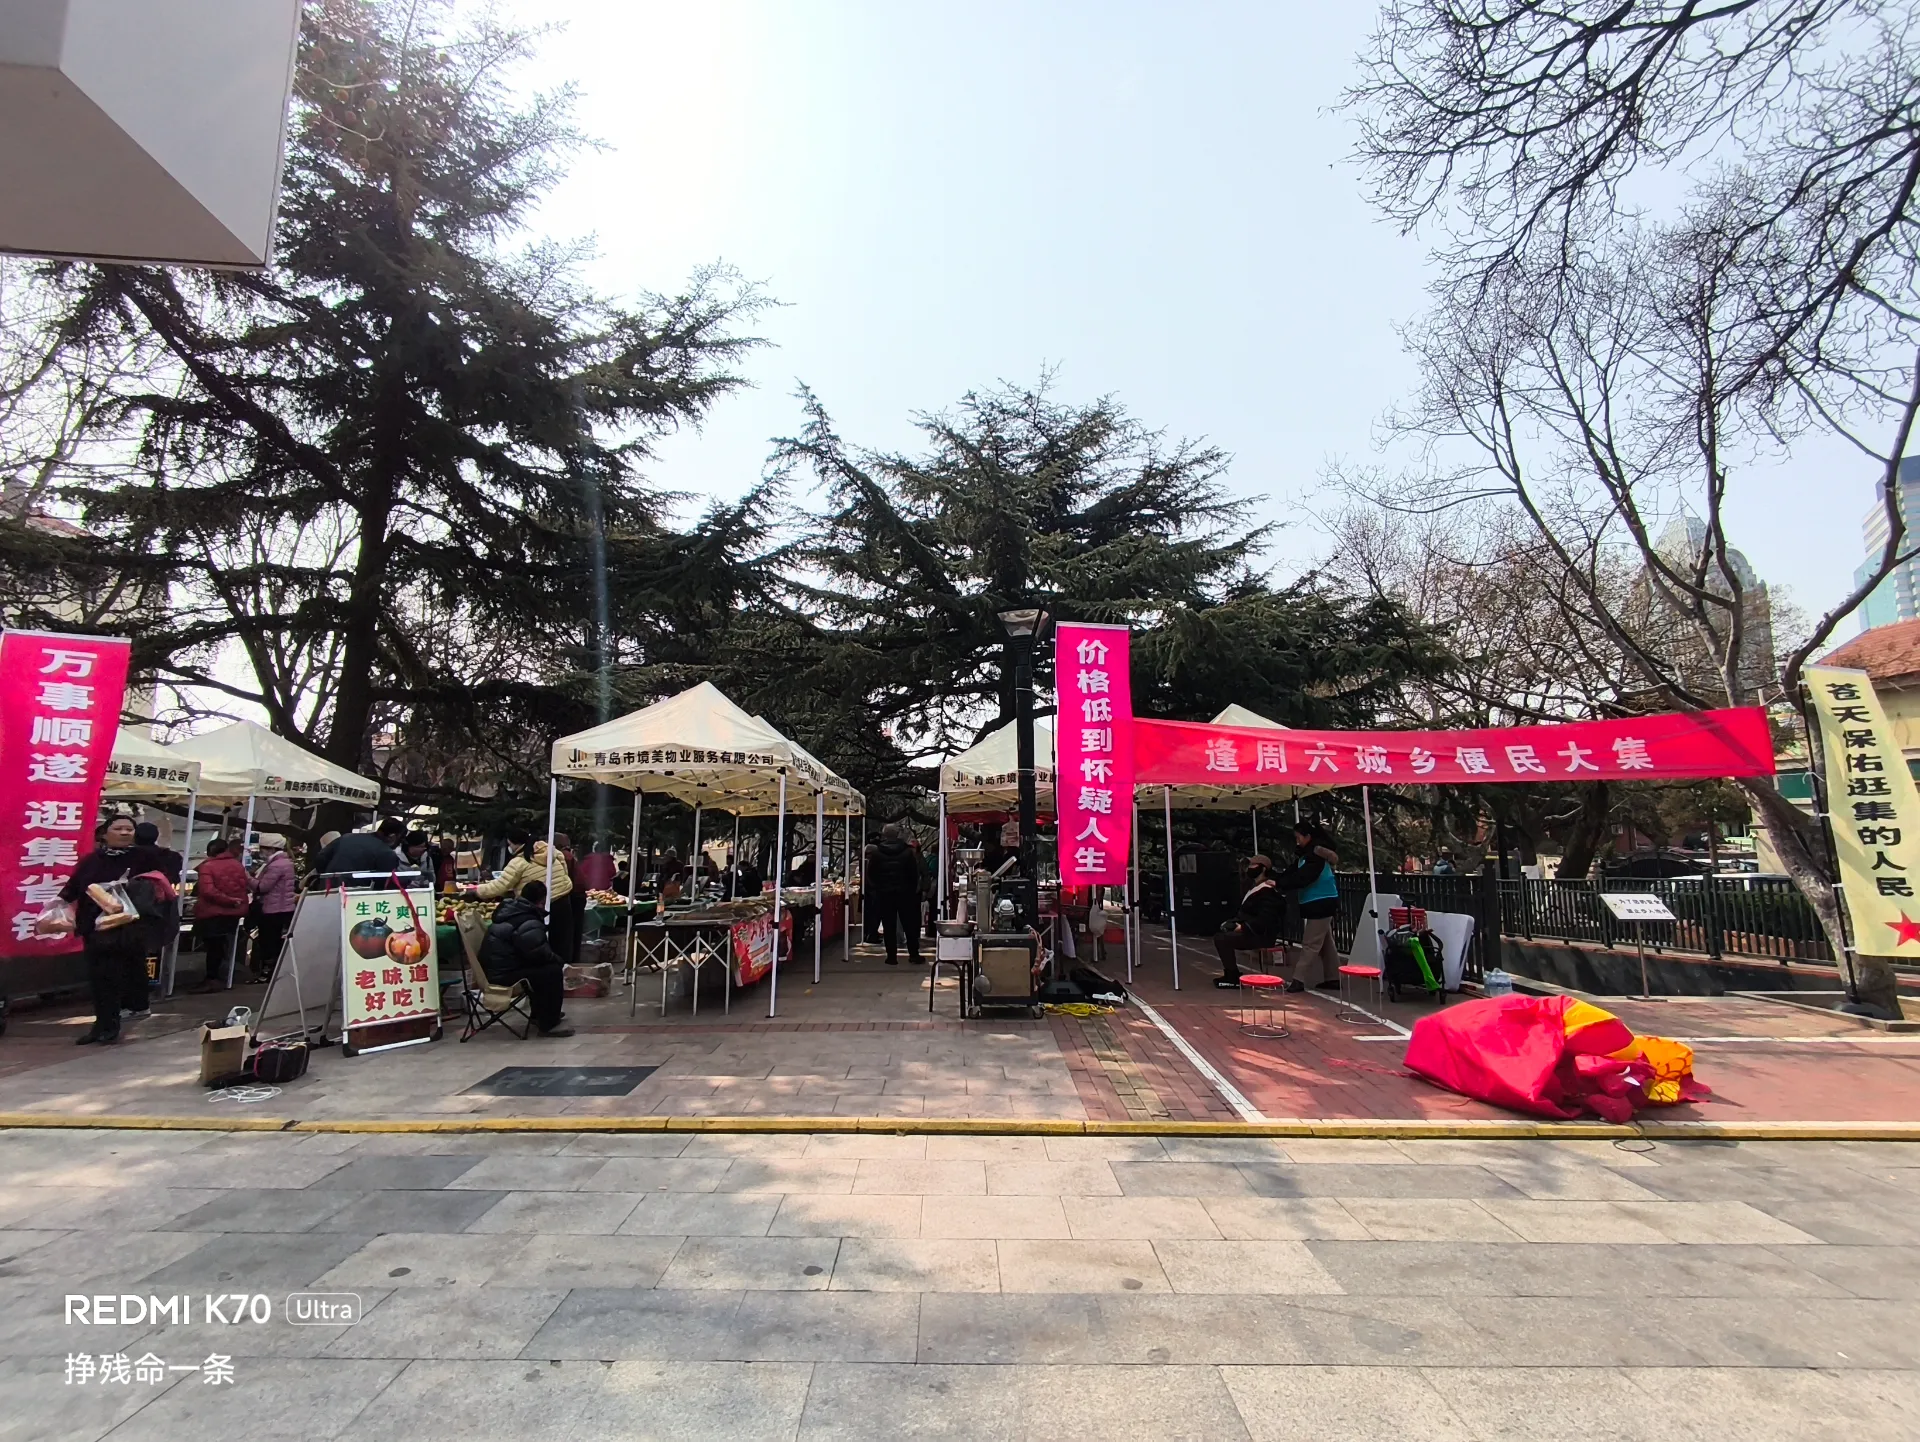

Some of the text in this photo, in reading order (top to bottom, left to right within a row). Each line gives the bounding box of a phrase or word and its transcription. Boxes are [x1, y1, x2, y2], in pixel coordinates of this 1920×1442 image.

[594, 749, 775, 766] 青岛市境美物业服务有限公司
[1075, 639, 1113, 872] 价格低到怀疑人生
[1204, 737, 1654, 775] 逢周六城乡便民大集
[1825, 683, 1914, 897] 苍天保佑逛集的人民
[355, 964, 429, 990] 老味道
